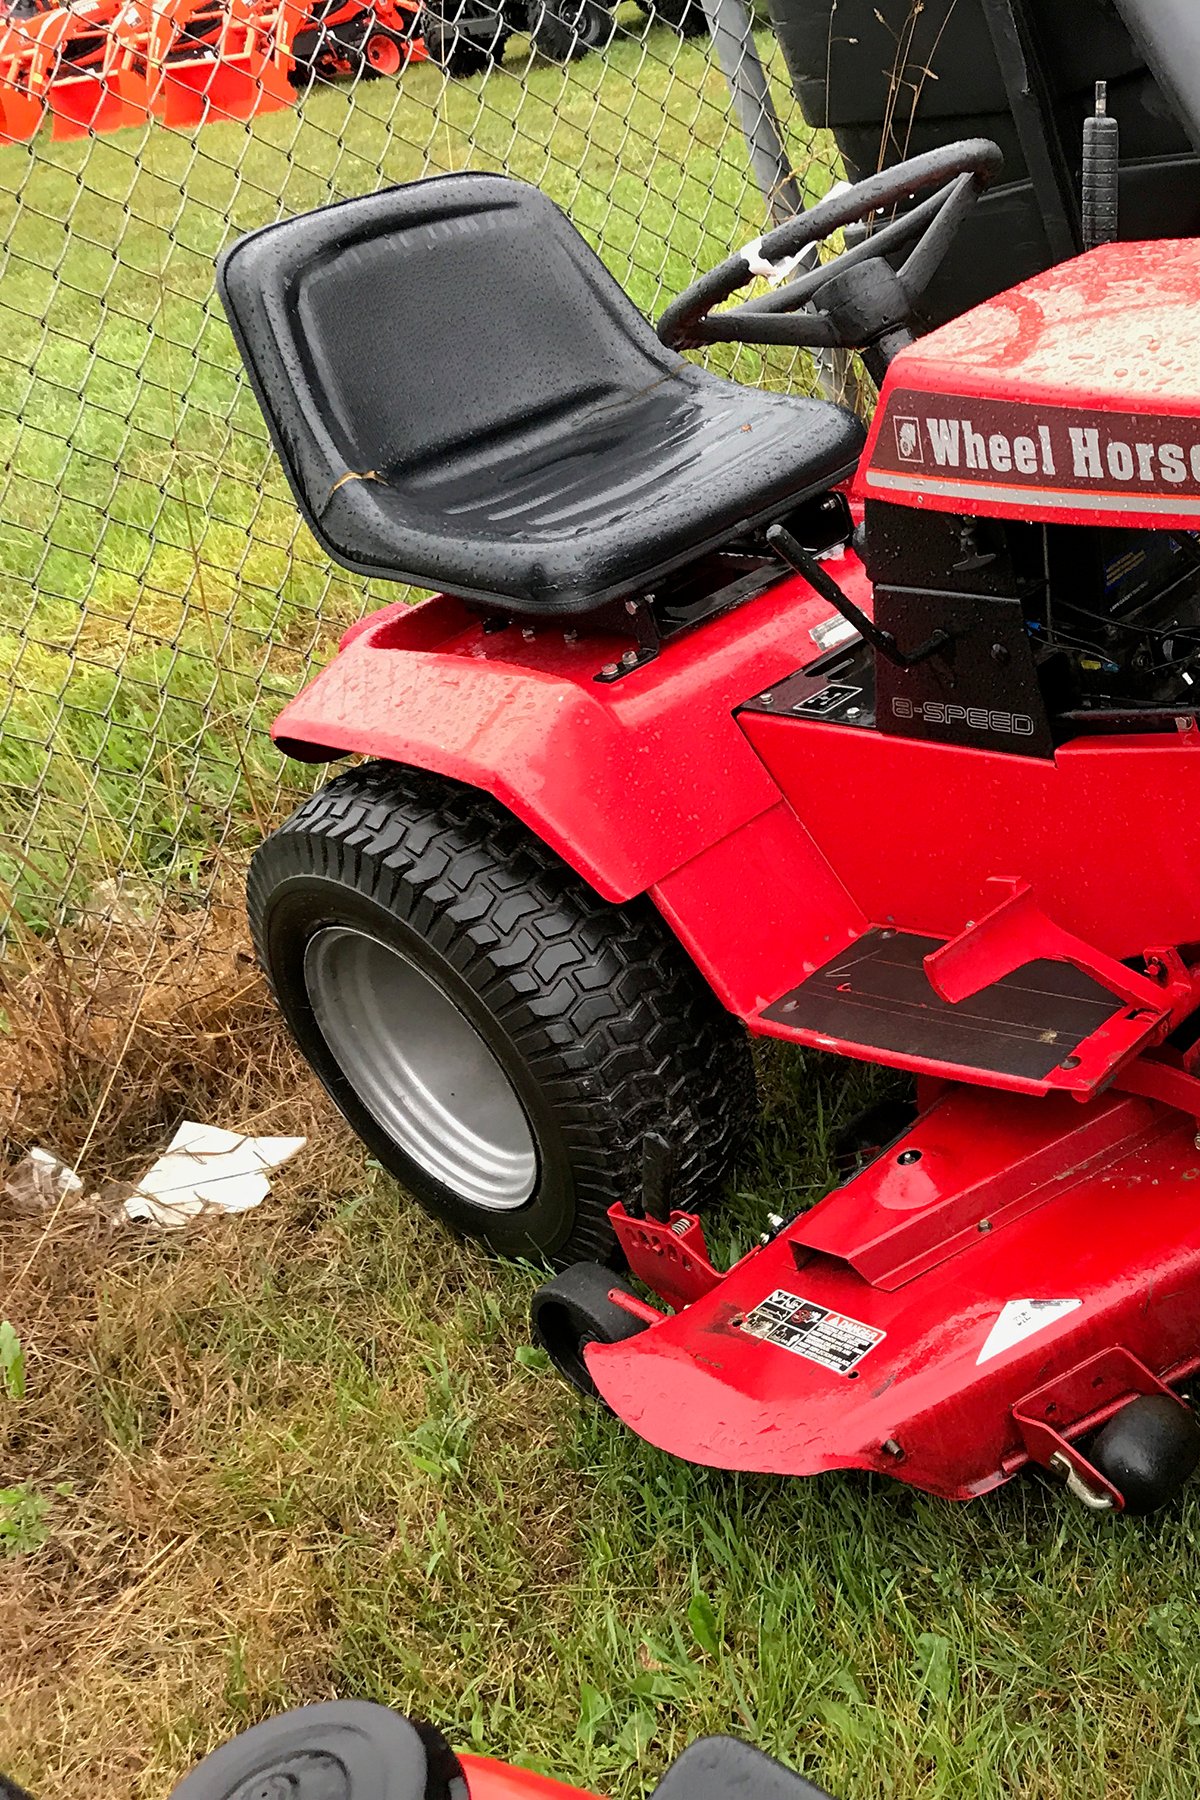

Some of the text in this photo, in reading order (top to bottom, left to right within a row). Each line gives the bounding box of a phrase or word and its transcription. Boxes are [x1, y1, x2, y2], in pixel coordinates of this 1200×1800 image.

[926, 418, 1056, 476] Wheel
[891, 697, 1034, 736] 8-SPEED
[840, 1319, 879, 1341] DANGER
